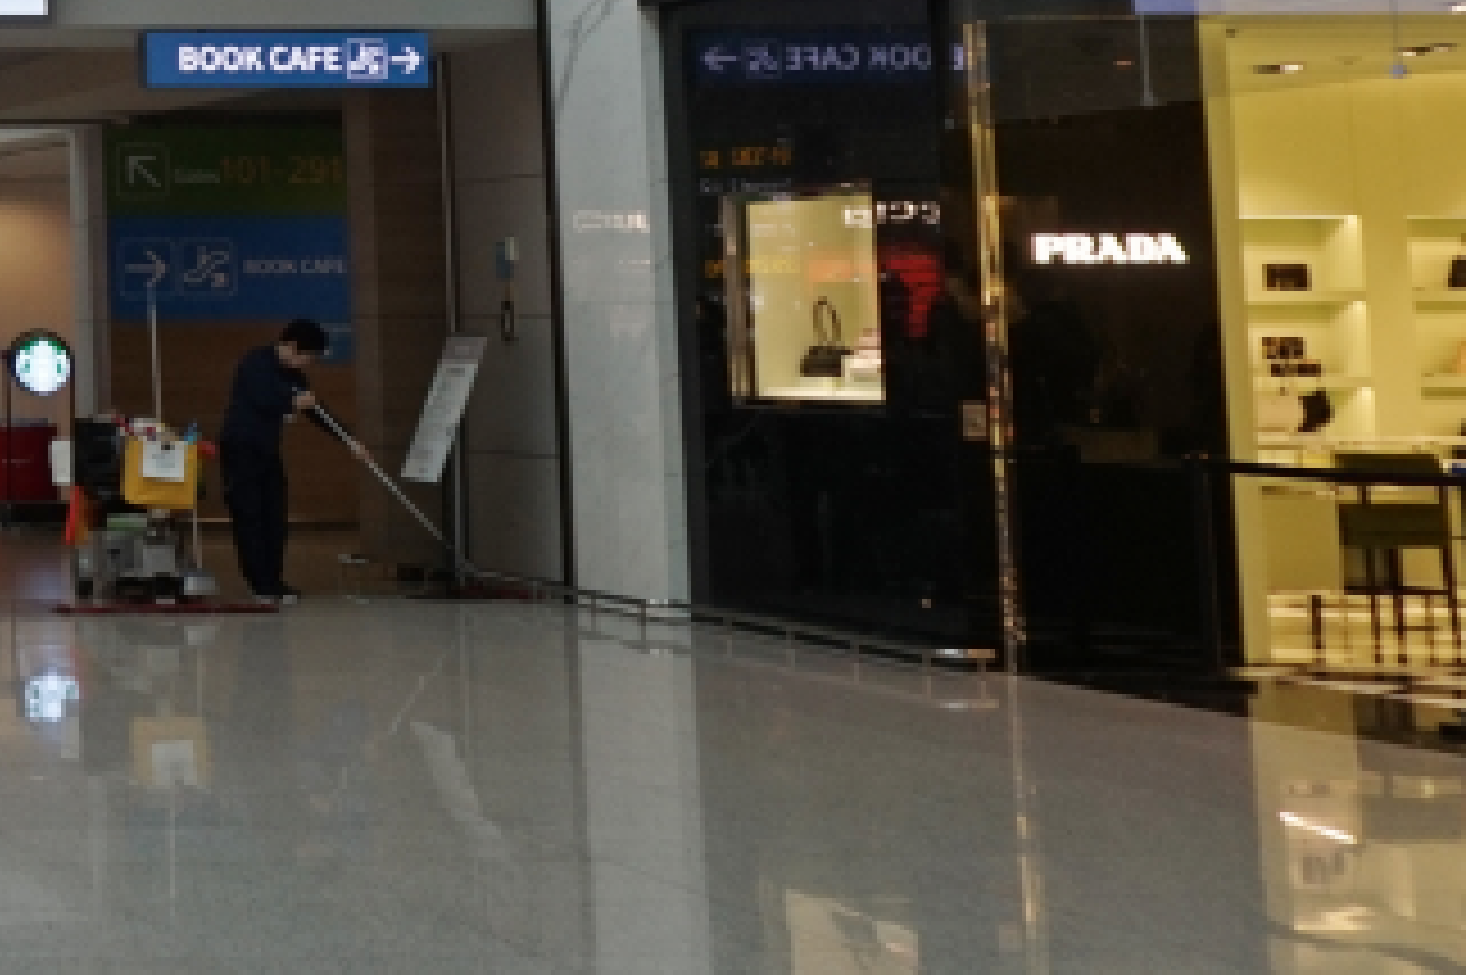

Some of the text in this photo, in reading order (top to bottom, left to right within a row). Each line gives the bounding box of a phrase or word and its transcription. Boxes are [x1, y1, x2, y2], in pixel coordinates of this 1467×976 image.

[177, 45, 343, 74] BOOK CAFE
[1032, 233, 1191, 265] PRADA
